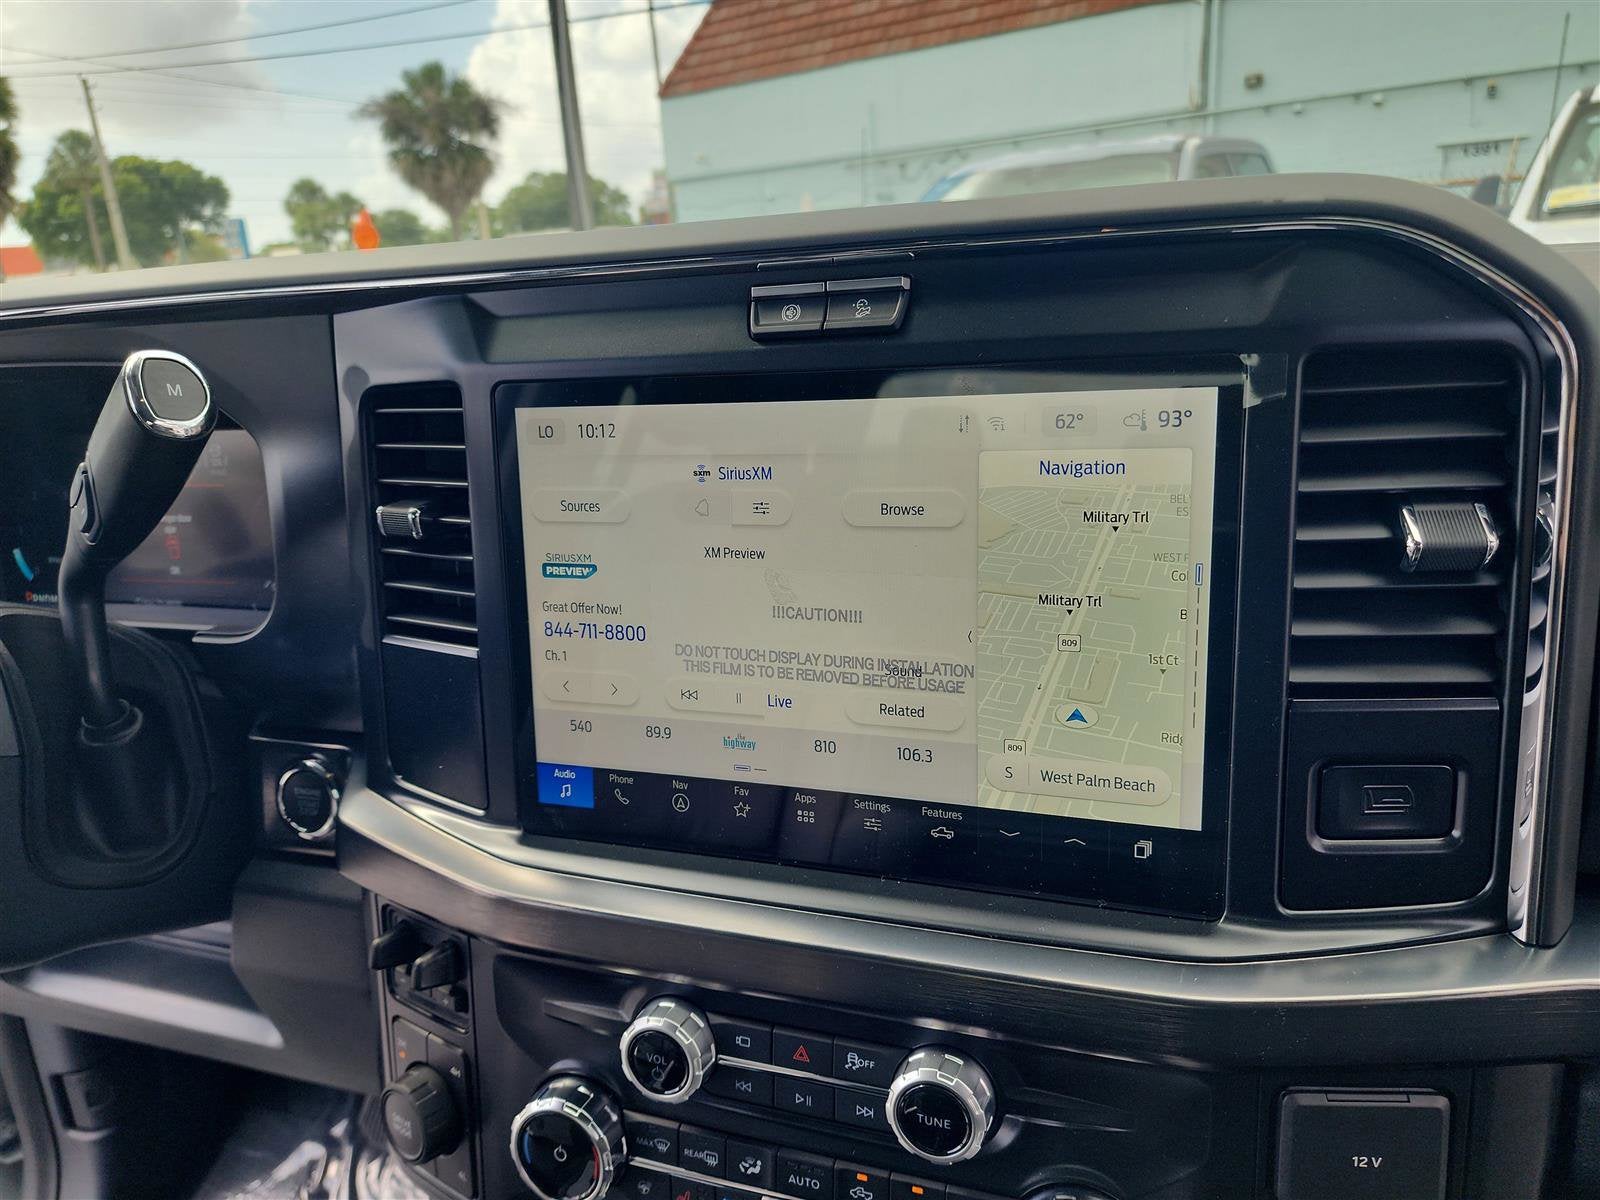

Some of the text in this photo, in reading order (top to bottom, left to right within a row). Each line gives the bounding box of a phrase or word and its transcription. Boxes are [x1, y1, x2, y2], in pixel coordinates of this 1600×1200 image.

[166, 383, 183, 397] M
[1055, 413, 1084, 430] 62°
[1158, 410, 1193, 428] 93°
[538, 425, 554, 439] LO
[577, 423, 616, 439] 10:12
[718, 466, 772, 481] SiriusXM
[1039, 460, 1126, 478] Navigation
[560, 499, 601, 513] Sources
[880, 502, 925, 517] Browse
[1083, 511, 1149, 526] Military Trl
[545, 553, 592, 563] SIRIUSXM
[704, 547, 766, 560] XM Preview
[1153, 553, 1181, 563] WEST
[546, 566, 592, 577] PREVIEW
[542, 601, 623, 616] Great Offer Now!
[1038, 594, 1102, 609] Military Trl
[544, 621, 646, 642] 844-711-8800
[1061, 639, 1078, 648] 809
[545, 650, 567, 662] Ch. 1
[675, 643, 975, 679] DO NOT TOUCH DISPLAY DURING INSTALLATION
[1149, 654, 1179, 666] 1st Ct
[683, 659, 966, 695] THIS FILM IS TO BE REMOVED BEFORE USAGE
[885, 663, 922, 678] Sound
[767, 694, 792, 709] Live
[879, 703, 925, 719] Related
[570, 720, 592, 733] 540
[645, 726, 672, 739] 89.9
[723, 736, 756, 751] highway
[814, 740, 837, 754] 810
[1007, 744, 1023, 752] 809
[896, 747, 933, 764] 106.3
[554, 769, 576, 780] Audio
[609, 774, 634, 785] Phone
[1005, 767, 1156, 793] S West Palm Beach
[672, 780, 689, 790] Nav
[734, 786, 750, 797] Fav
[794, 793, 817, 805] Apps
[854, 799, 891, 813] Settings
[922, 806, 963, 821] Features
[645, 1052, 667, 1066] VOL
[857, 1058, 875, 1070] OFF
[916, 1111, 952, 1130] TUNE
[636, 1136, 655, 1147] MAX
[1351, 1156, 1382, 1168] 12 V
[788, 1173, 820, 1191] AUTO
